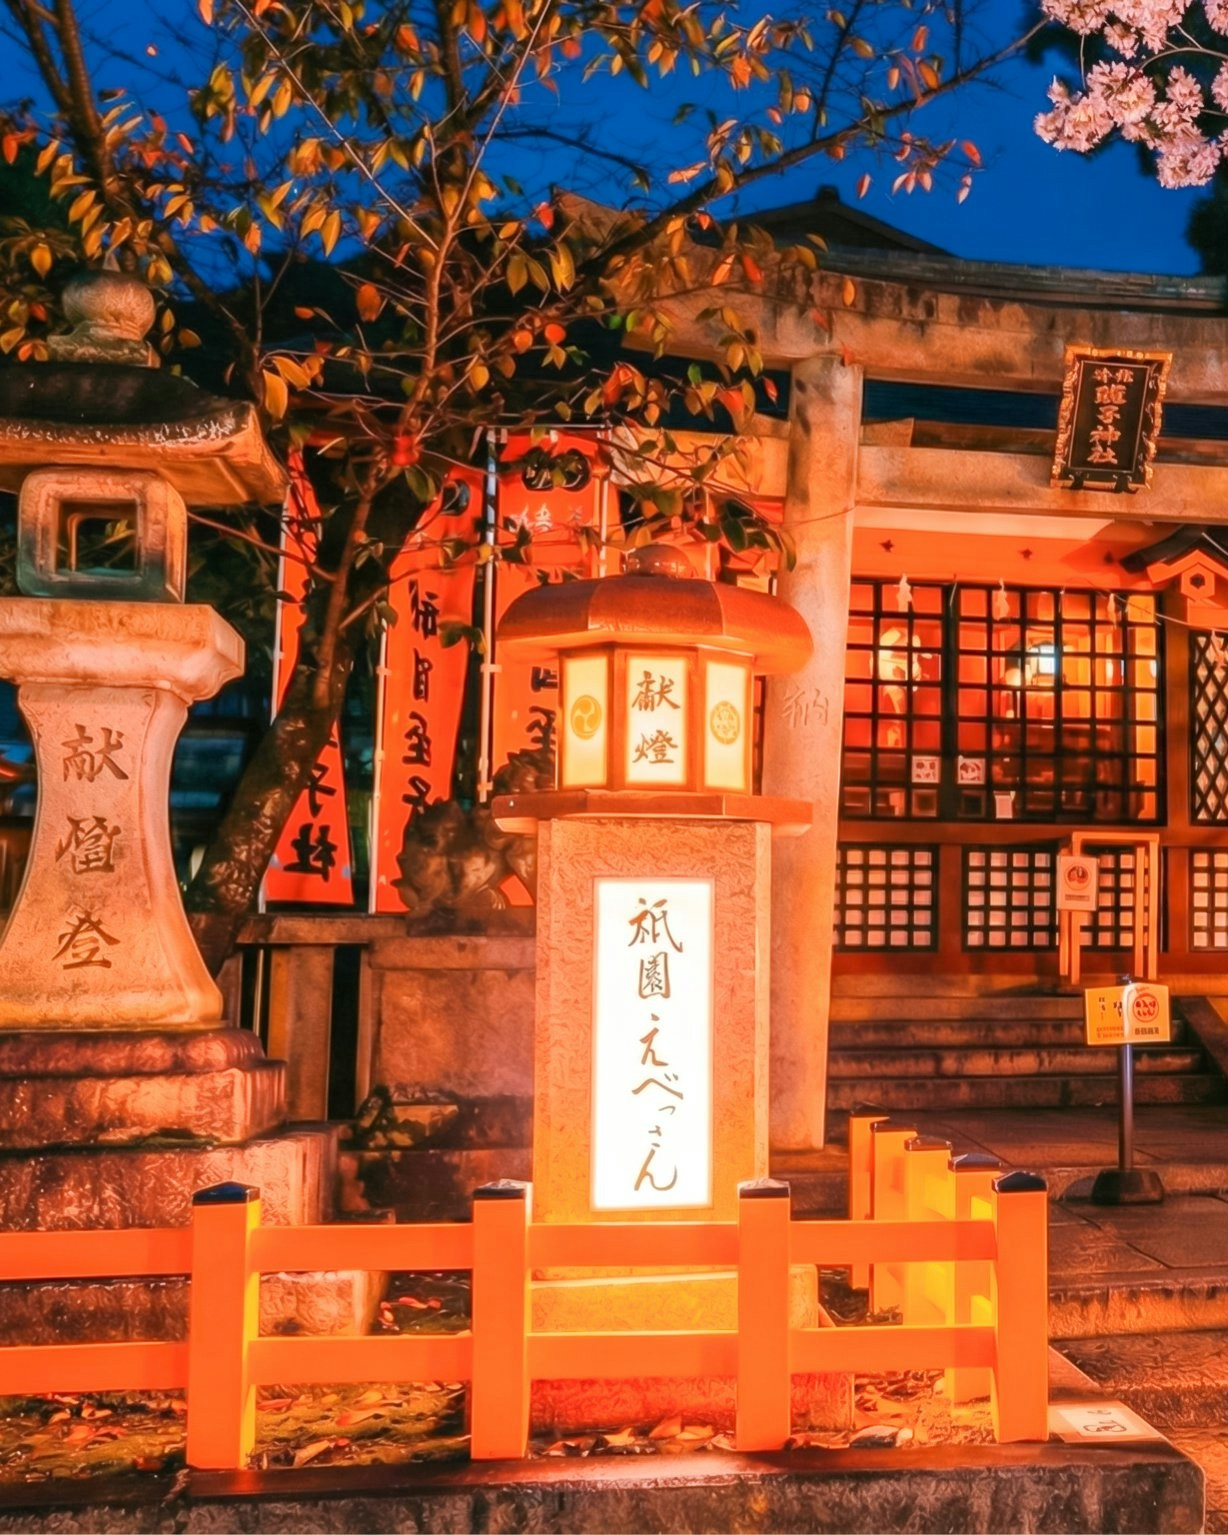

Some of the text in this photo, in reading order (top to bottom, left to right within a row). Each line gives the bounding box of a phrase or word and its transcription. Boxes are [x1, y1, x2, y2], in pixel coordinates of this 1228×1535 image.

[627, 897, 684, 1192] 祇園えべっさん
